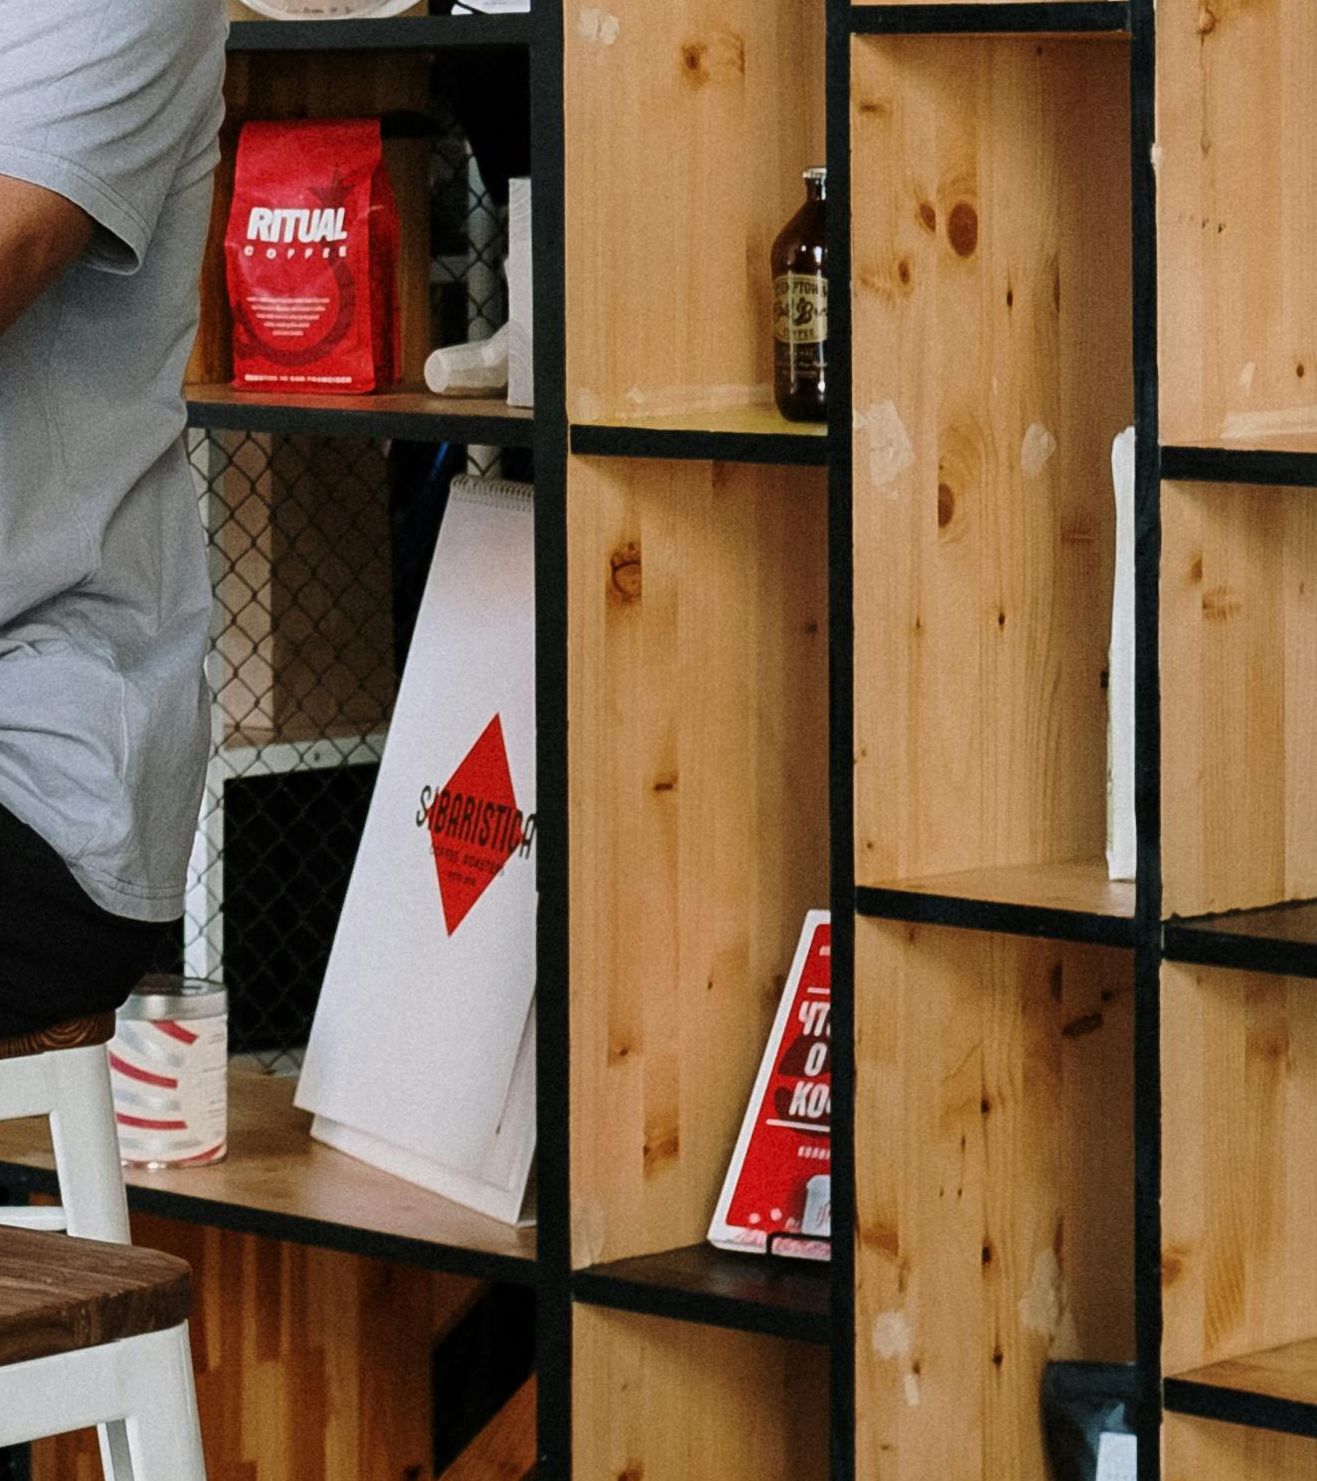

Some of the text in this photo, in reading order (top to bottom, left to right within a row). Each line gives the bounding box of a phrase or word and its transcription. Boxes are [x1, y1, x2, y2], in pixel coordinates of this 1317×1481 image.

[246, 206, 348, 244] RITUAL
[243, 245, 348, 260] COFFEE
[416, 784, 536, 860] SIBARISTICA
